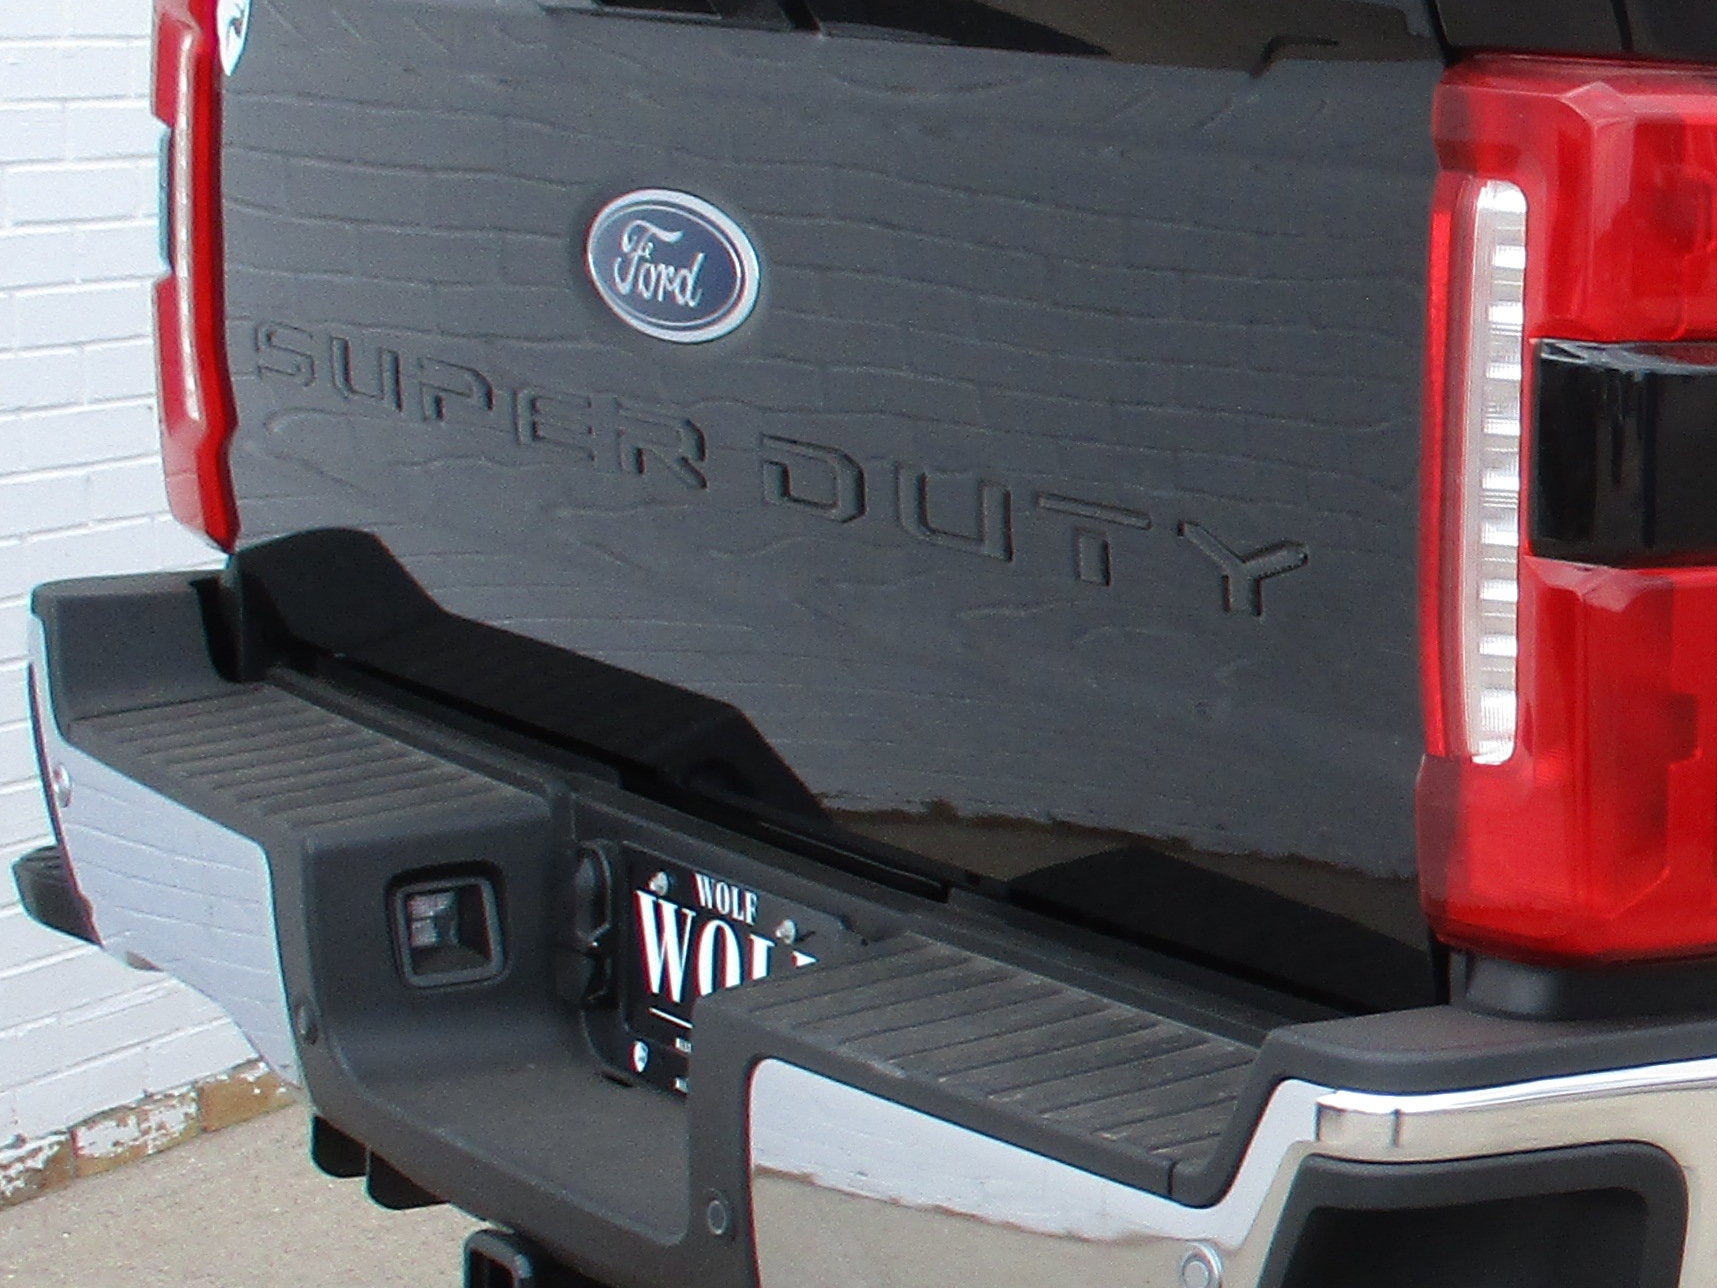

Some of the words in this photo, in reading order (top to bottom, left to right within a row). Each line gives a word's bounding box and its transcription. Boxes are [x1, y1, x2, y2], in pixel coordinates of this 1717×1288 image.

[614, 219, 706, 308] Ford
[254, 320, 709, 490] SUPER
[761, 433, 1309, 617] DUTY
[692, 872, 758, 926] WOLF
